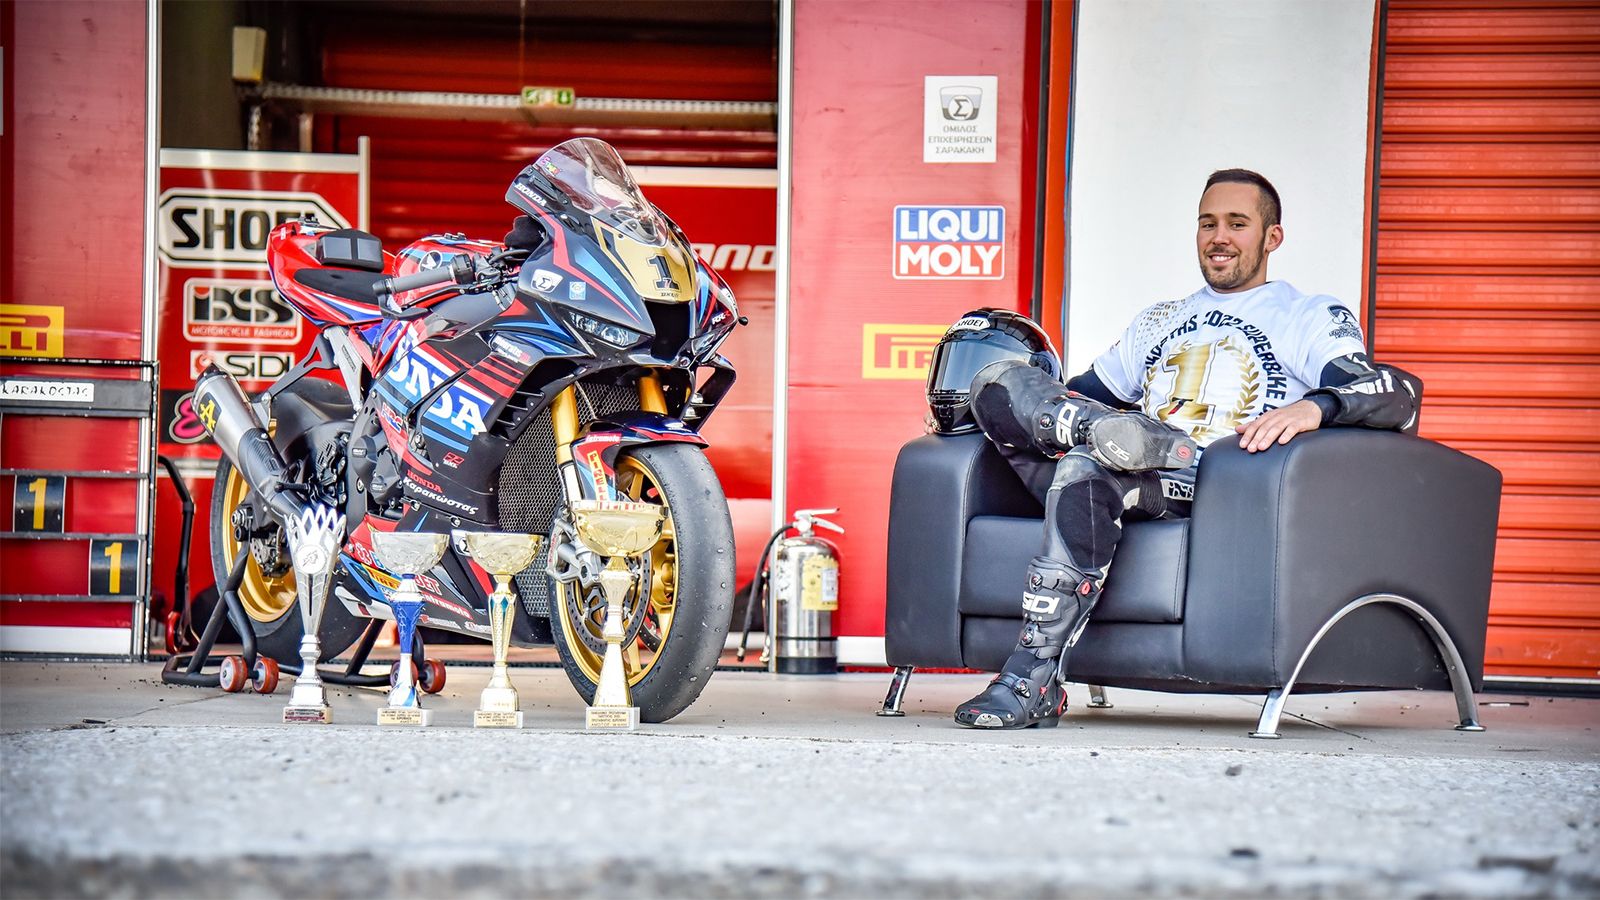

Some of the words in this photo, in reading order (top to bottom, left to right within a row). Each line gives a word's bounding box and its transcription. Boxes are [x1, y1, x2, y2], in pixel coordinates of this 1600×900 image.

[942, 125, 977, 133] ΟΜΙΛΟΣ
[935, 146, 985, 154] ΣΑΡΑΚΑΚΗ
[514, 182, 547, 207] HONDA
[900, 209, 999, 242] LIQUI
[648, 254, 681, 291] 1
[899, 244, 1002, 276] MOLY
[1242, 323, 1288, 401] SUPERBIKE
[2, 383, 88, 397] KARAKOSTAS
[1156, 343, 1214, 424] 1
[406, 469, 443, 493] HONDA
[588, 452, 607, 502] PIREL
[28, 478, 48, 530] 1
[402, 476, 479, 515] Καρακώστας
[104, 542, 123, 594] 1
